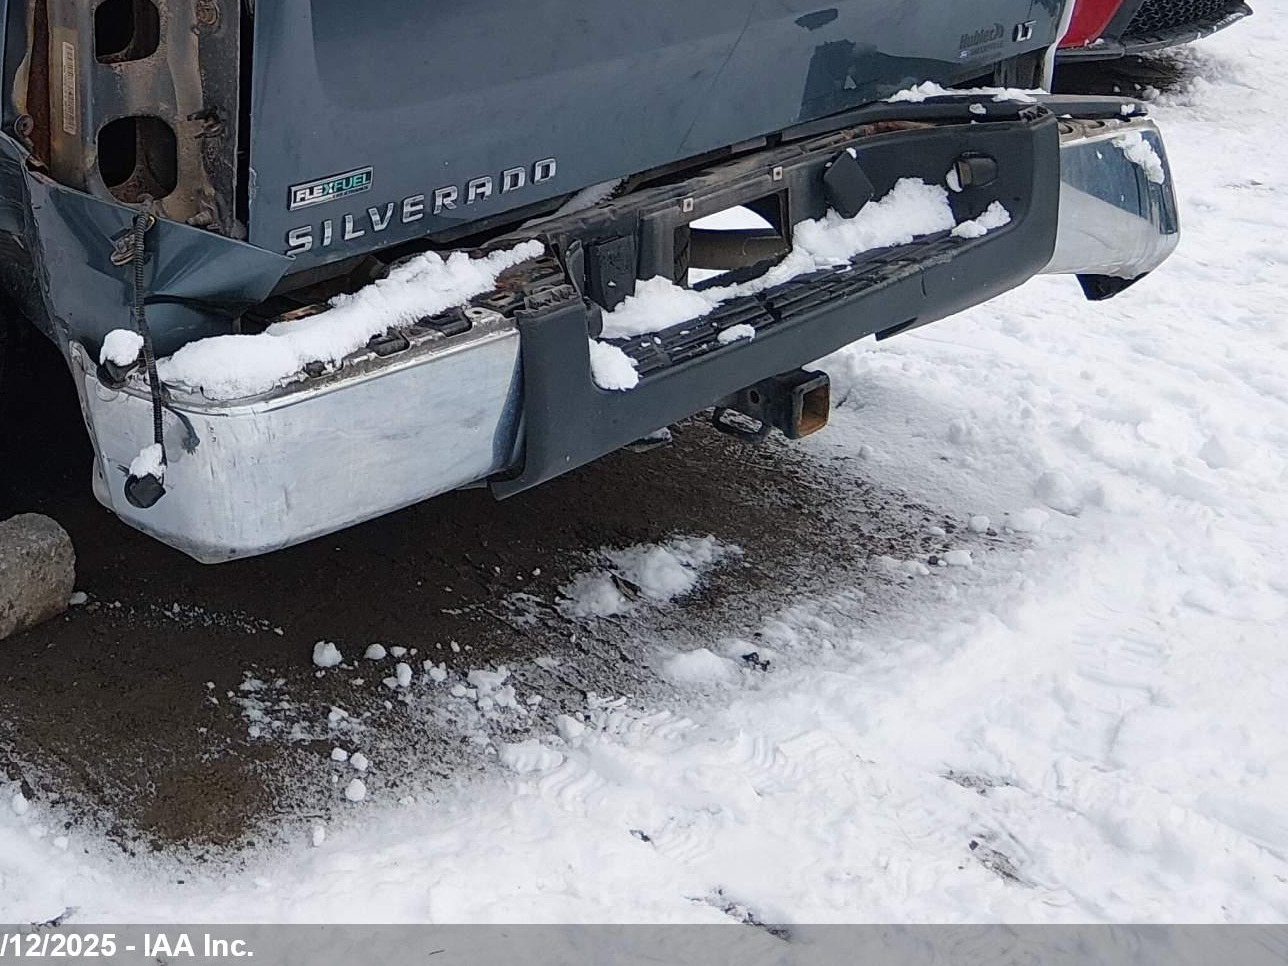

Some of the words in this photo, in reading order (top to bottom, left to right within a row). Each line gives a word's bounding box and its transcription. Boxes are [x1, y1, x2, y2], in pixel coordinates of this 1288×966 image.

[1014, 20, 1037, 43] LT
[294, 172, 373, 203] FLEXFUEL
[285, 157, 557, 257] SILVERADO
